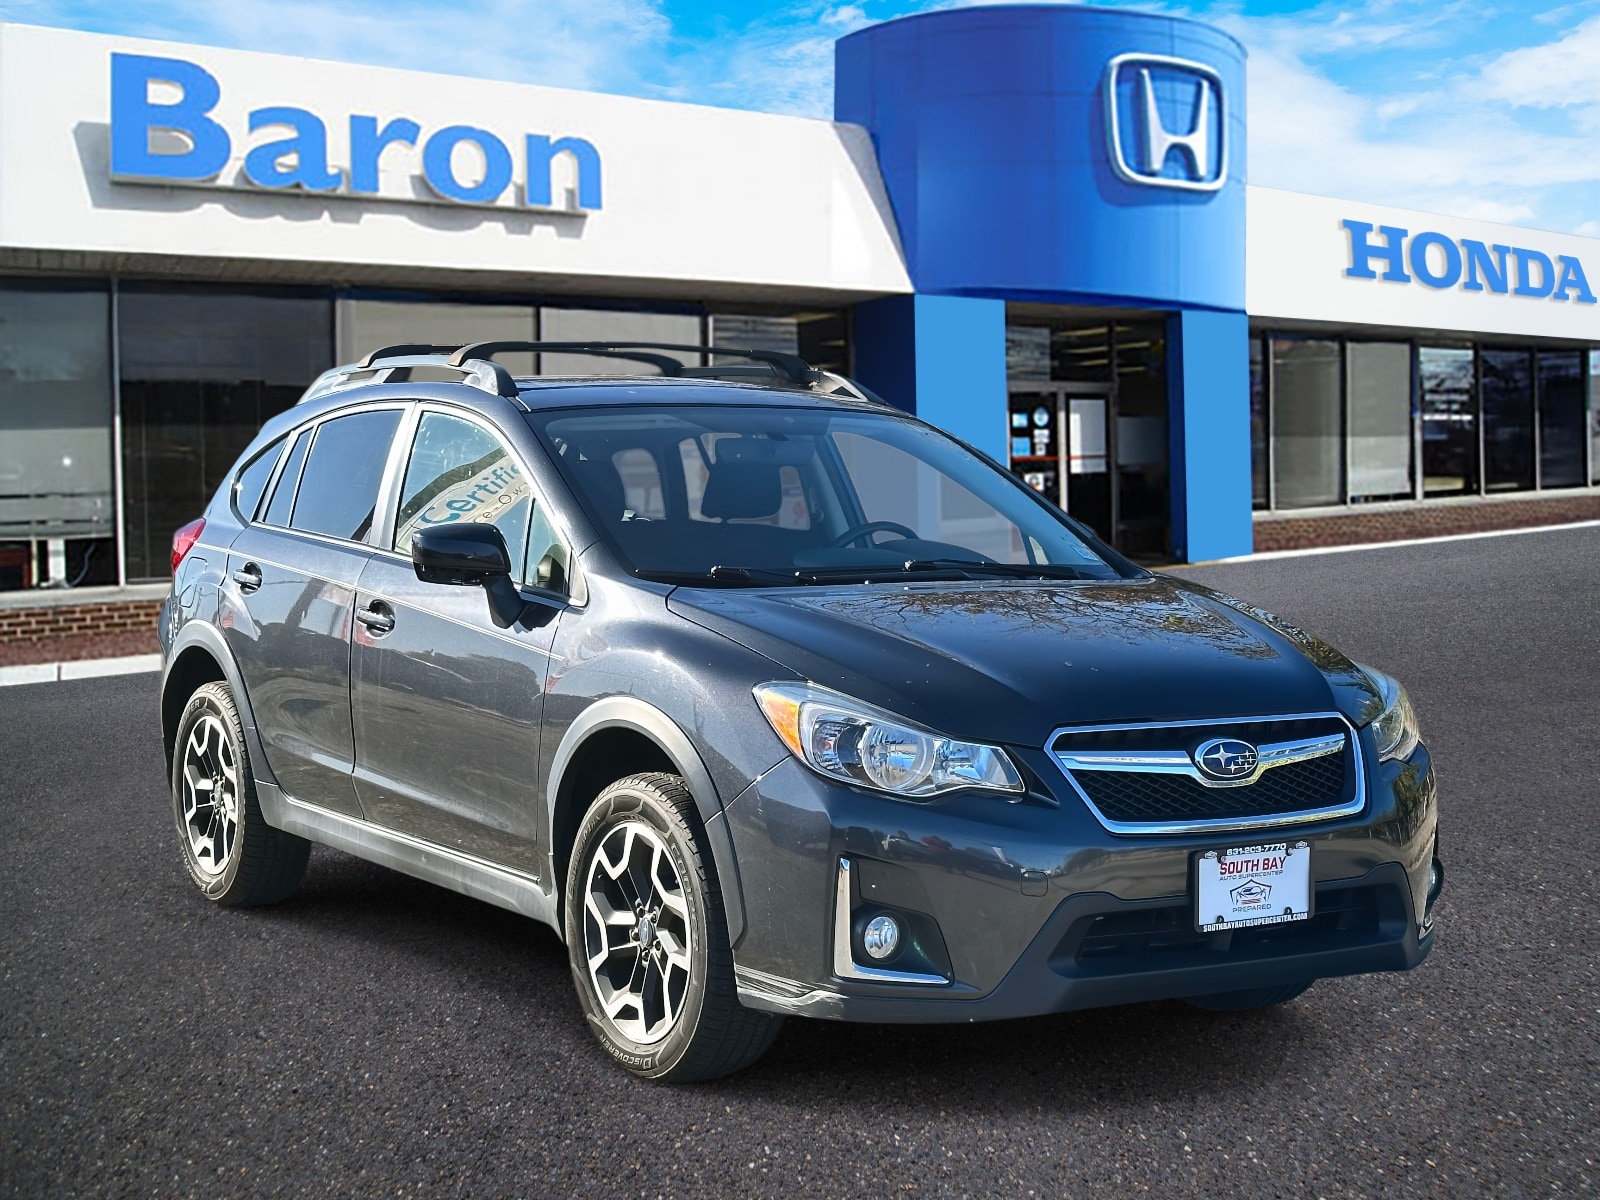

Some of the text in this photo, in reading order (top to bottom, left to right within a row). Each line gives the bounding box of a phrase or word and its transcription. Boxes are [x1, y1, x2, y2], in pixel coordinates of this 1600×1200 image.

[110, 51, 603, 211] Baron
[1342, 218, 1598, 304] HONDA
[1226, 842, 1287, 856] 631-203-7770
[1219, 856, 1287, 876] SOUTH BAY
[1238, 869, 1284, 880] SUPERCENTER
[1232, 903, 1272, 914] PREPARED
[1203, 912, 1308, 933] SOUTHBAYAUTOSUPERCENTER.COM
